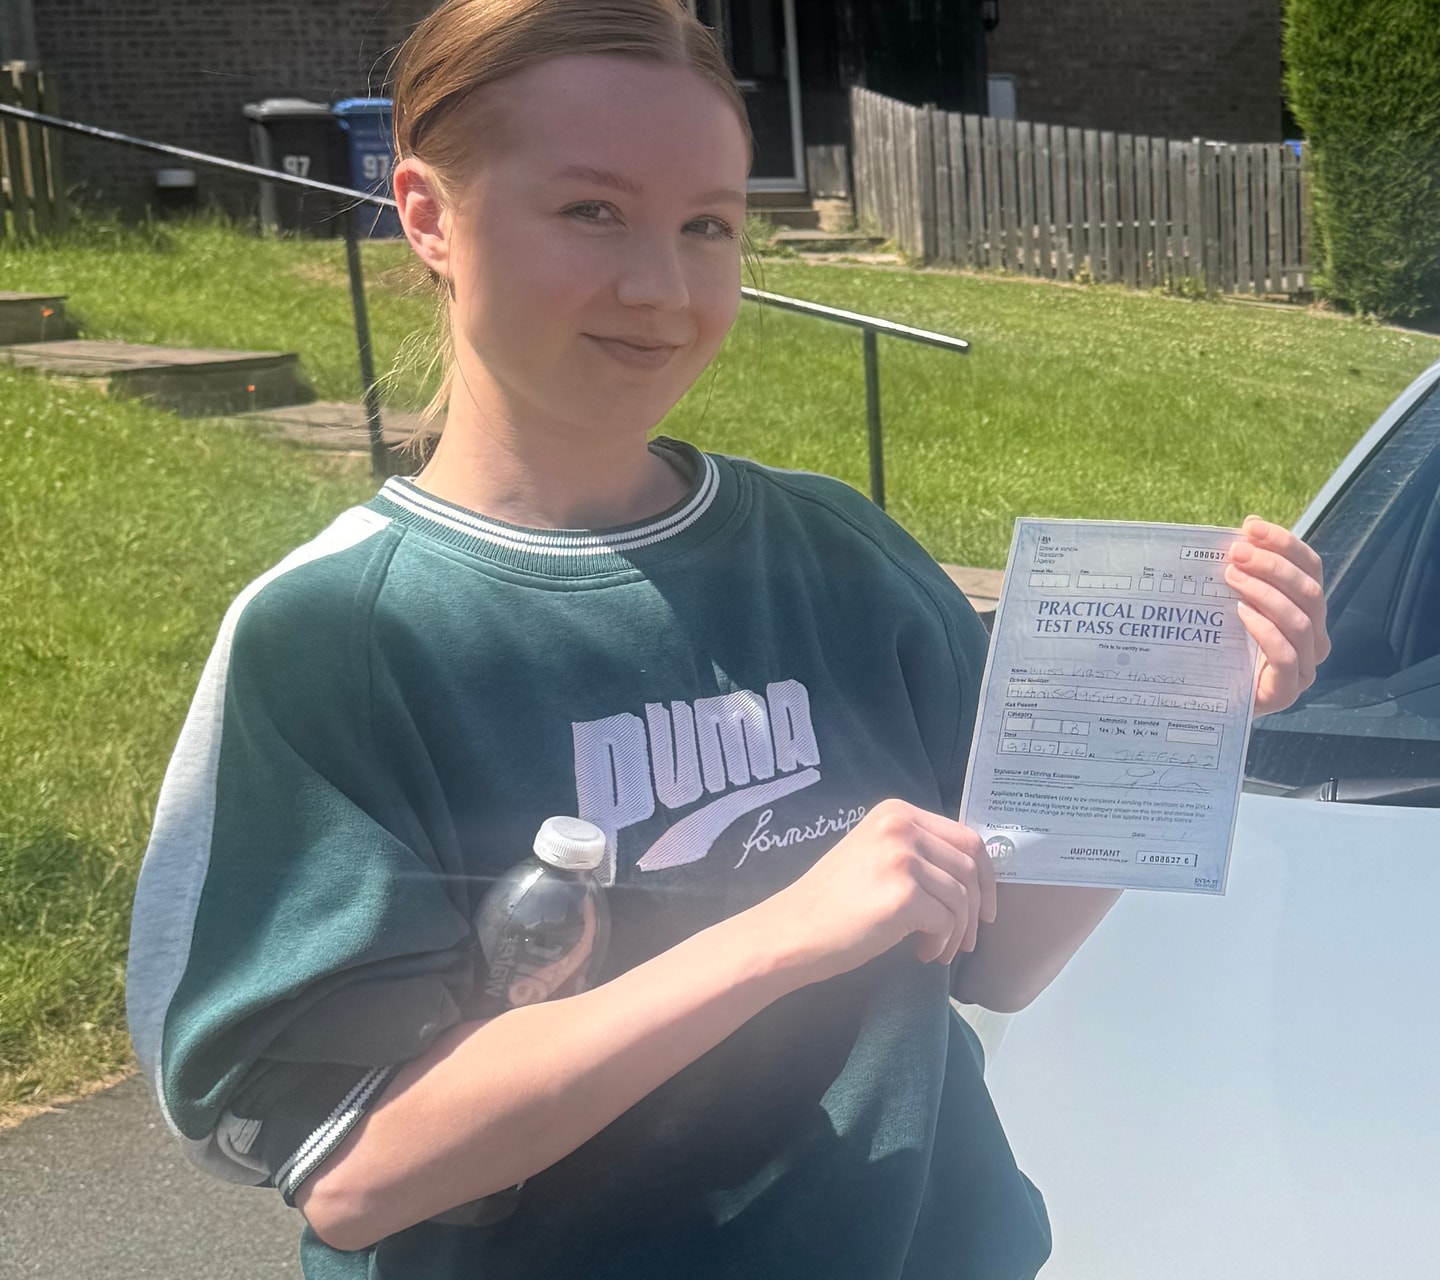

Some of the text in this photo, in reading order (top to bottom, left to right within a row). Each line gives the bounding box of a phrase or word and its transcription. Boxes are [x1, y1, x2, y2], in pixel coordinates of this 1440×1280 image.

[283, 155, 311, 178] 97
[1038, 600, 1224, 627] PRACTICAL DRIVING
[1035, 619, 1222, 644] TEST PASS CERTIFICATE
[734, 806, 866, 869] formstripe
[1070, 847, 1121, 858] IMPORTANT
